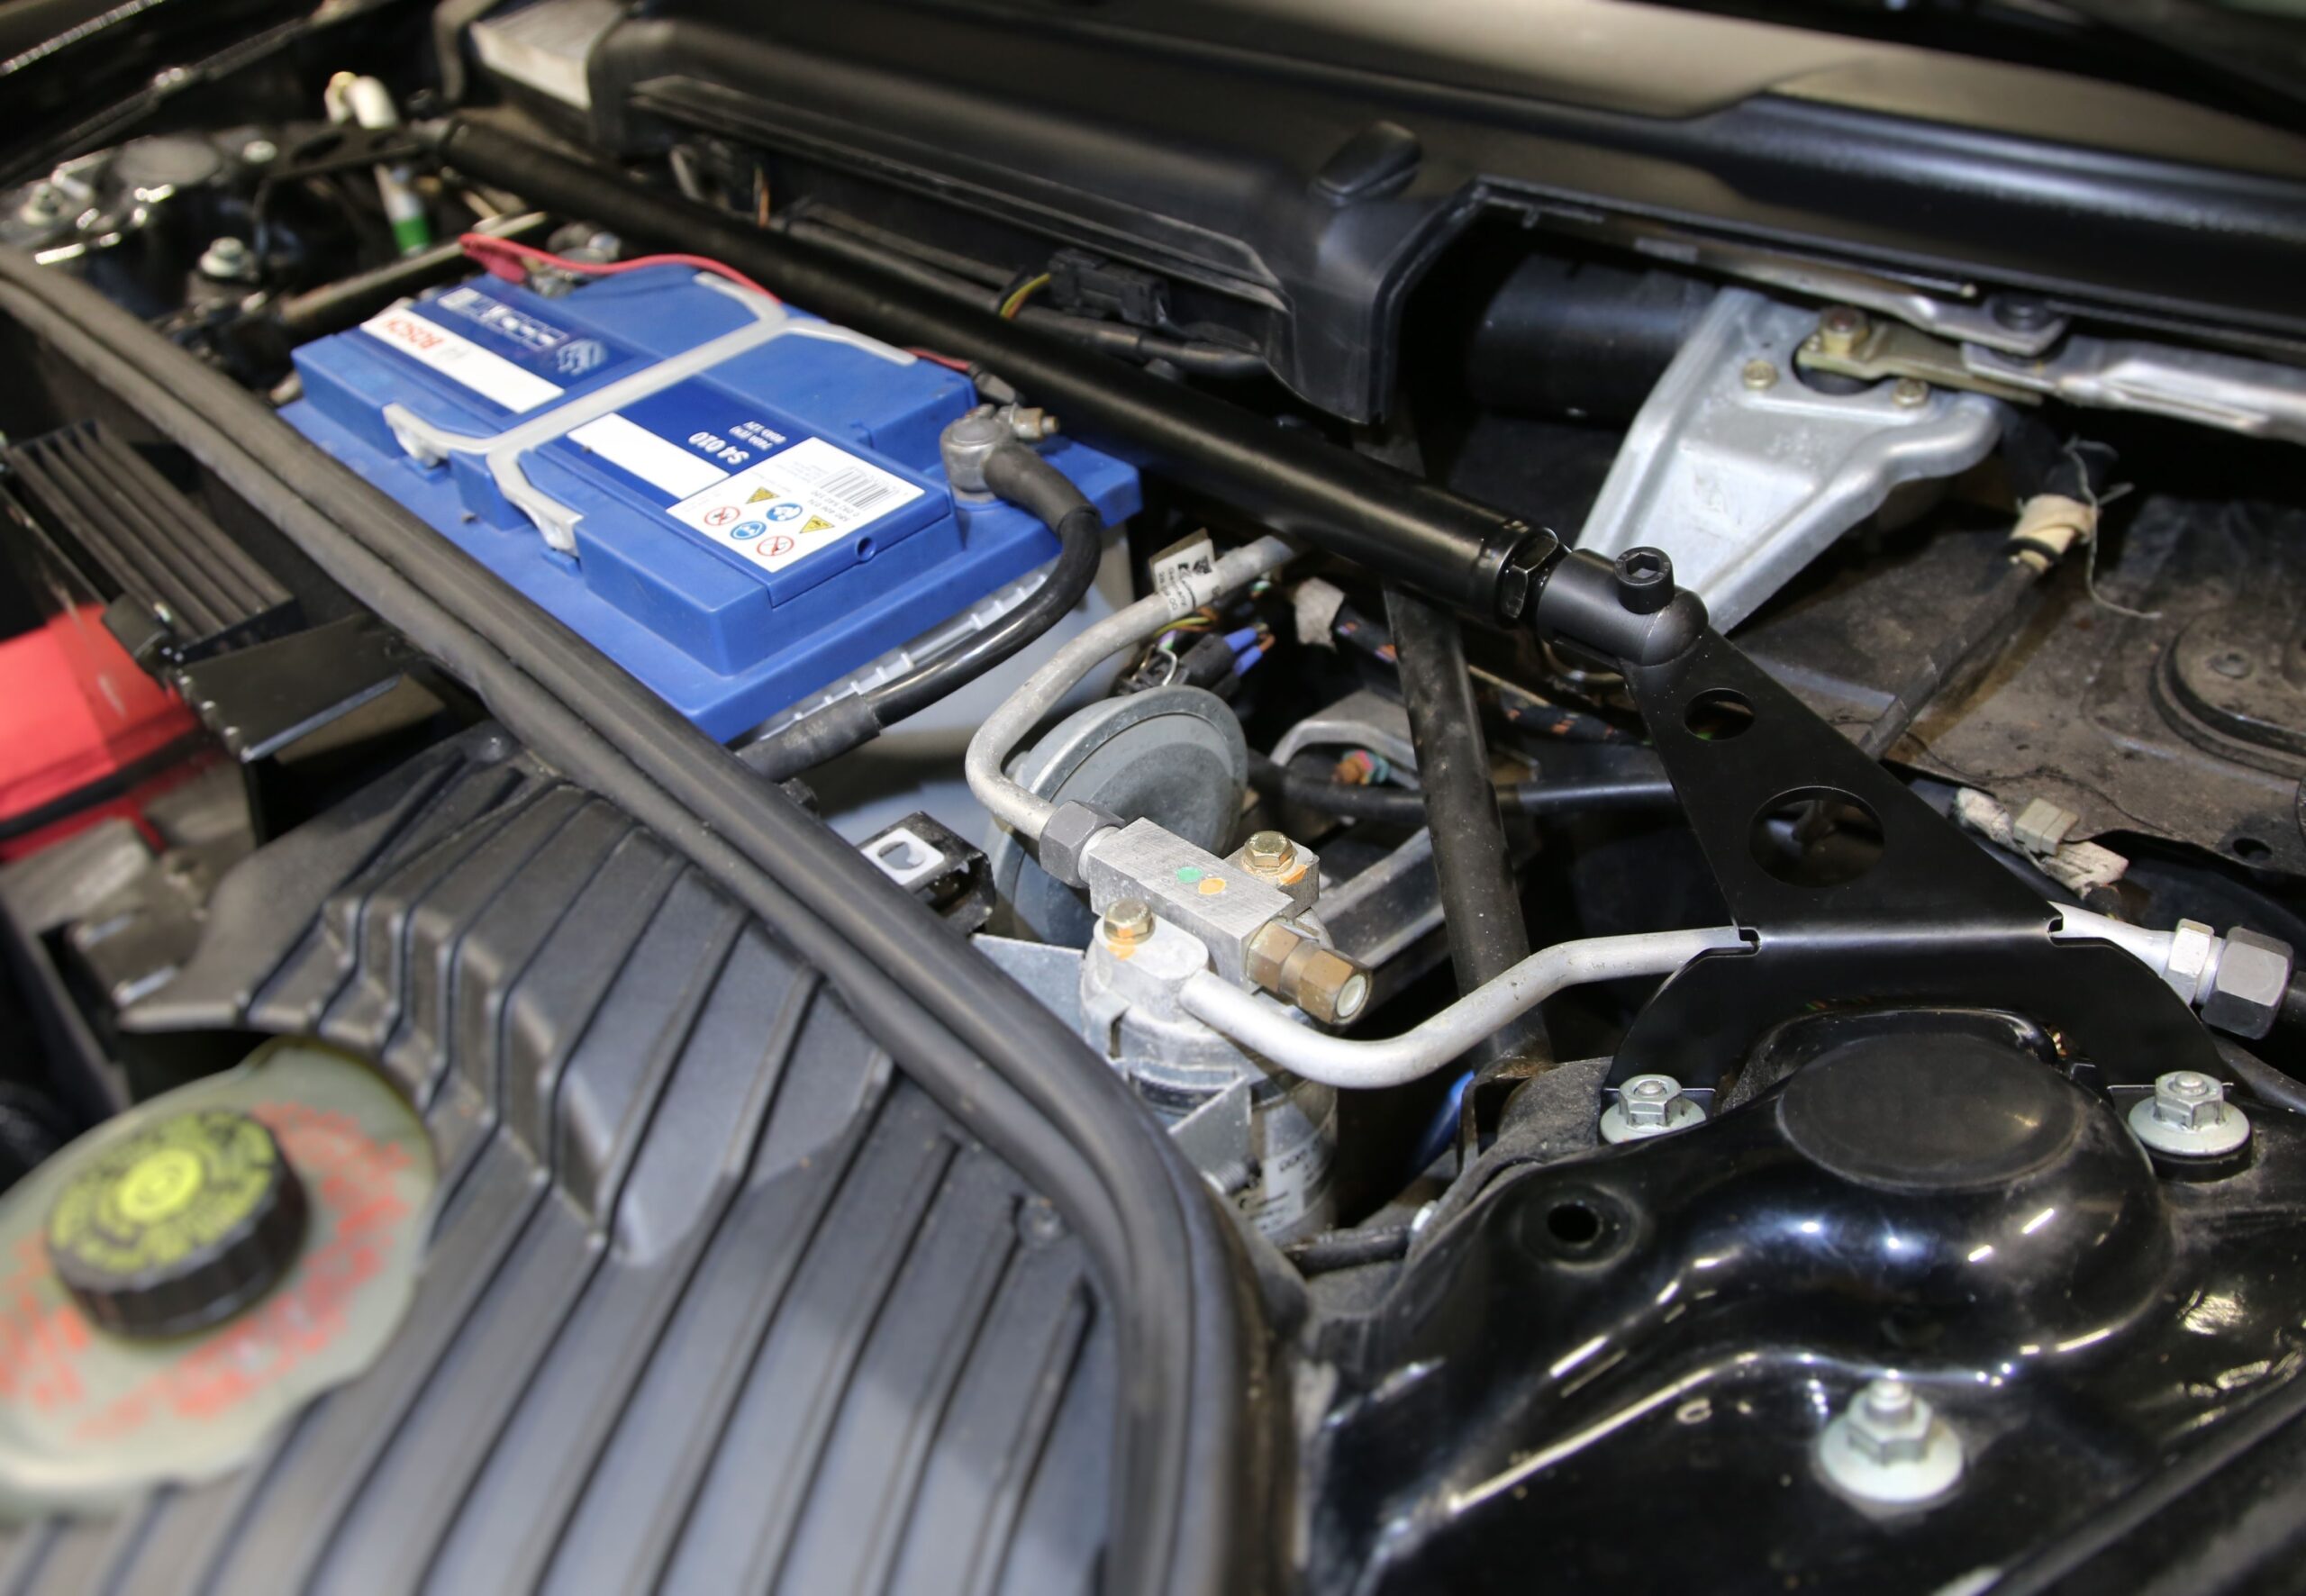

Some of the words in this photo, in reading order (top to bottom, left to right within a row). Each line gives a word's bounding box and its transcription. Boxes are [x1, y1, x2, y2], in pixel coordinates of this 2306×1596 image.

[380, 317, 446, 350] BOSCH
[688, 432, 726, 453] 010
[717, 446, 749, 465] S4
